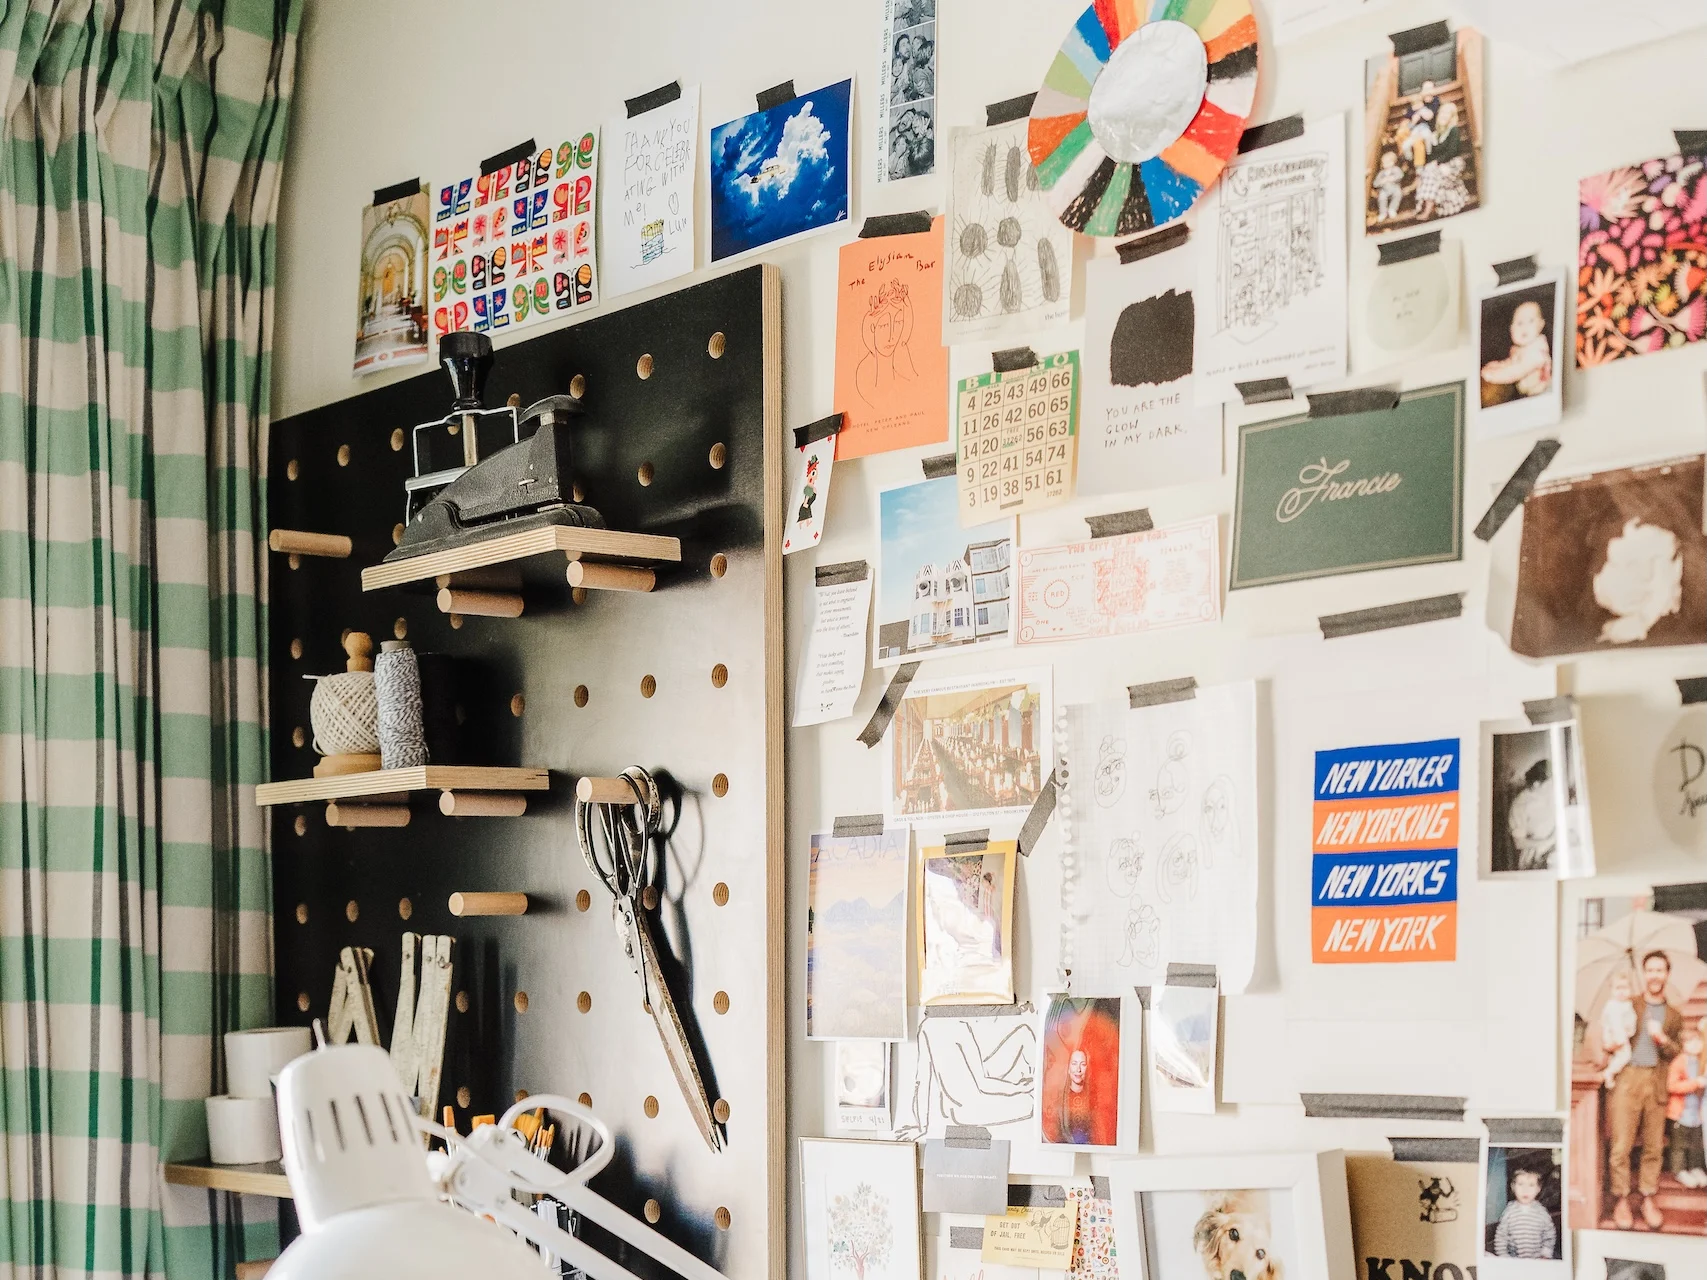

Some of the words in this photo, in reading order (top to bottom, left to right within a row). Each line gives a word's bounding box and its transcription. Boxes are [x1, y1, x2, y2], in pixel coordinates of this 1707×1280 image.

[625, 129, 668, 153] THANK
[624, 153, 652, 185] FOR
[661, 162, 685, 187] WITH
[868, 252, 914, 272] Elysian
[916, 260, 936, 271] Bar
[968, 395, 976, 410] 4
[984, 390, 1001, 407] 25
[1007, 383, 1024, 400] 43
[1030, 377, 1047, 394] 49
[1052, 371, 1070, 388] 66
[1106, 405, 1128, 421] YOU
[1134, 400, 1155, 414] ARE
[1159, 392, 1181, 406] THE
[963, 418, 978, 436] 11
[983, 413, 999, 431] 26
[1005, 407, 1022, 424] 42
[1028, 401, 1046, 418] 60
[1050, 395, 1069, 413] 65
[1106, 419, 1139, 435] GLOW
[963, 442, 978, 460] 14
[982, 437, 999, 455] 20
[1027, 425, 1044, 443] 56
[1049, 420, 1067, 437] 63
[1104, 439, 1117, 448] IN
[1124, 433, 1142, 444] MY
[967, 467, 975, 483] 9
[982, 461, 998, 479] 22
[1003, 455, 1019, 472] 41
[1026, 449, 1043, 467] 54
[1048, 444, 1066, 462] 74
[969, 491, 976, 507] 3
[984, 485, 998, 503] 19
[1003, 479, 1019, 497] 38
[1025, 474, 1040, 491] 51
[1046, 469, 1063, 486] 61
[1276, 456, 1402, 523] Francie
[1051, 590, 1065, 598] RED
[1369, 754, 1454, 792] YORKER
[1318, 864, 1375, 900] NEW
[1369, 860, 1450, 897] YORKS
[1322, 918, 1380, 953] NEW
[1379, 915, 1447, 952] YORK
